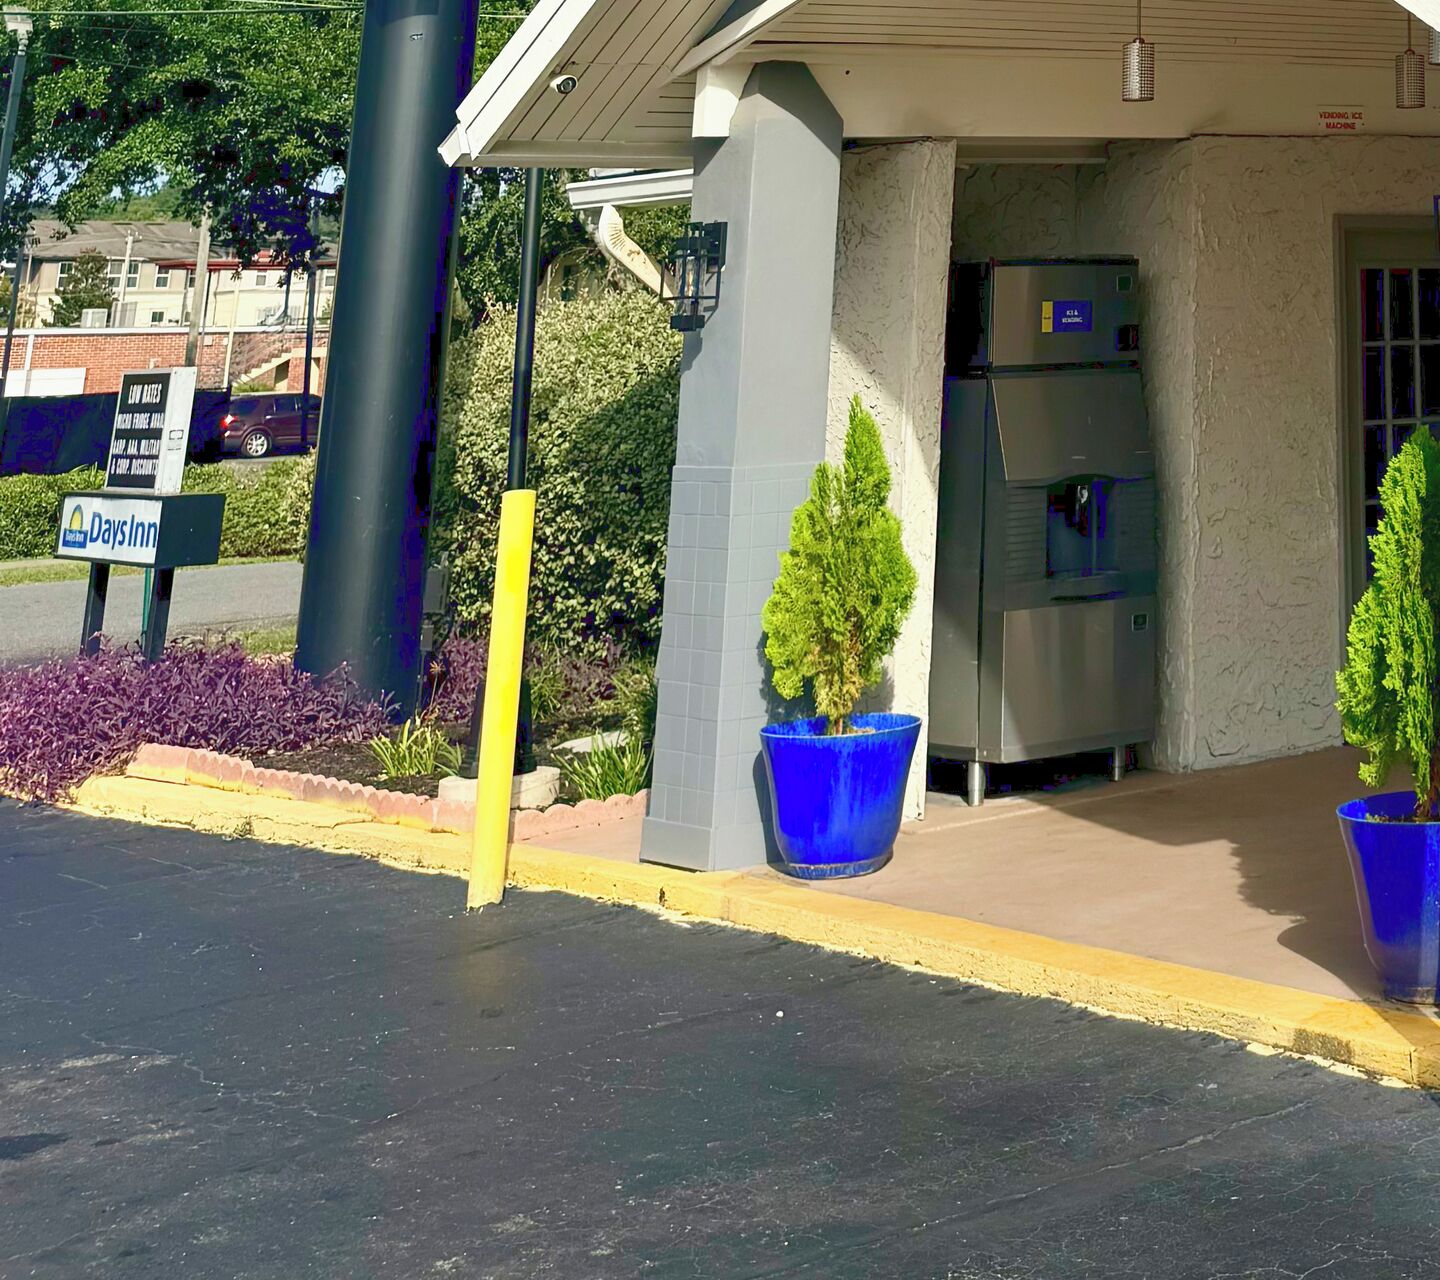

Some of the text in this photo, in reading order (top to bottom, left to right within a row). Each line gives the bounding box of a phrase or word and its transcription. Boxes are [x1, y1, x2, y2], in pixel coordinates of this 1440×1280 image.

[1352, 111, 1363, 120] ICE
[128, 384, 162, 404] LOW RATES
[116, 412, 132, 430] MICRO
[132, 412, 150, 429] FRIDGE
[89, 511, 158, 550] Days Inn
